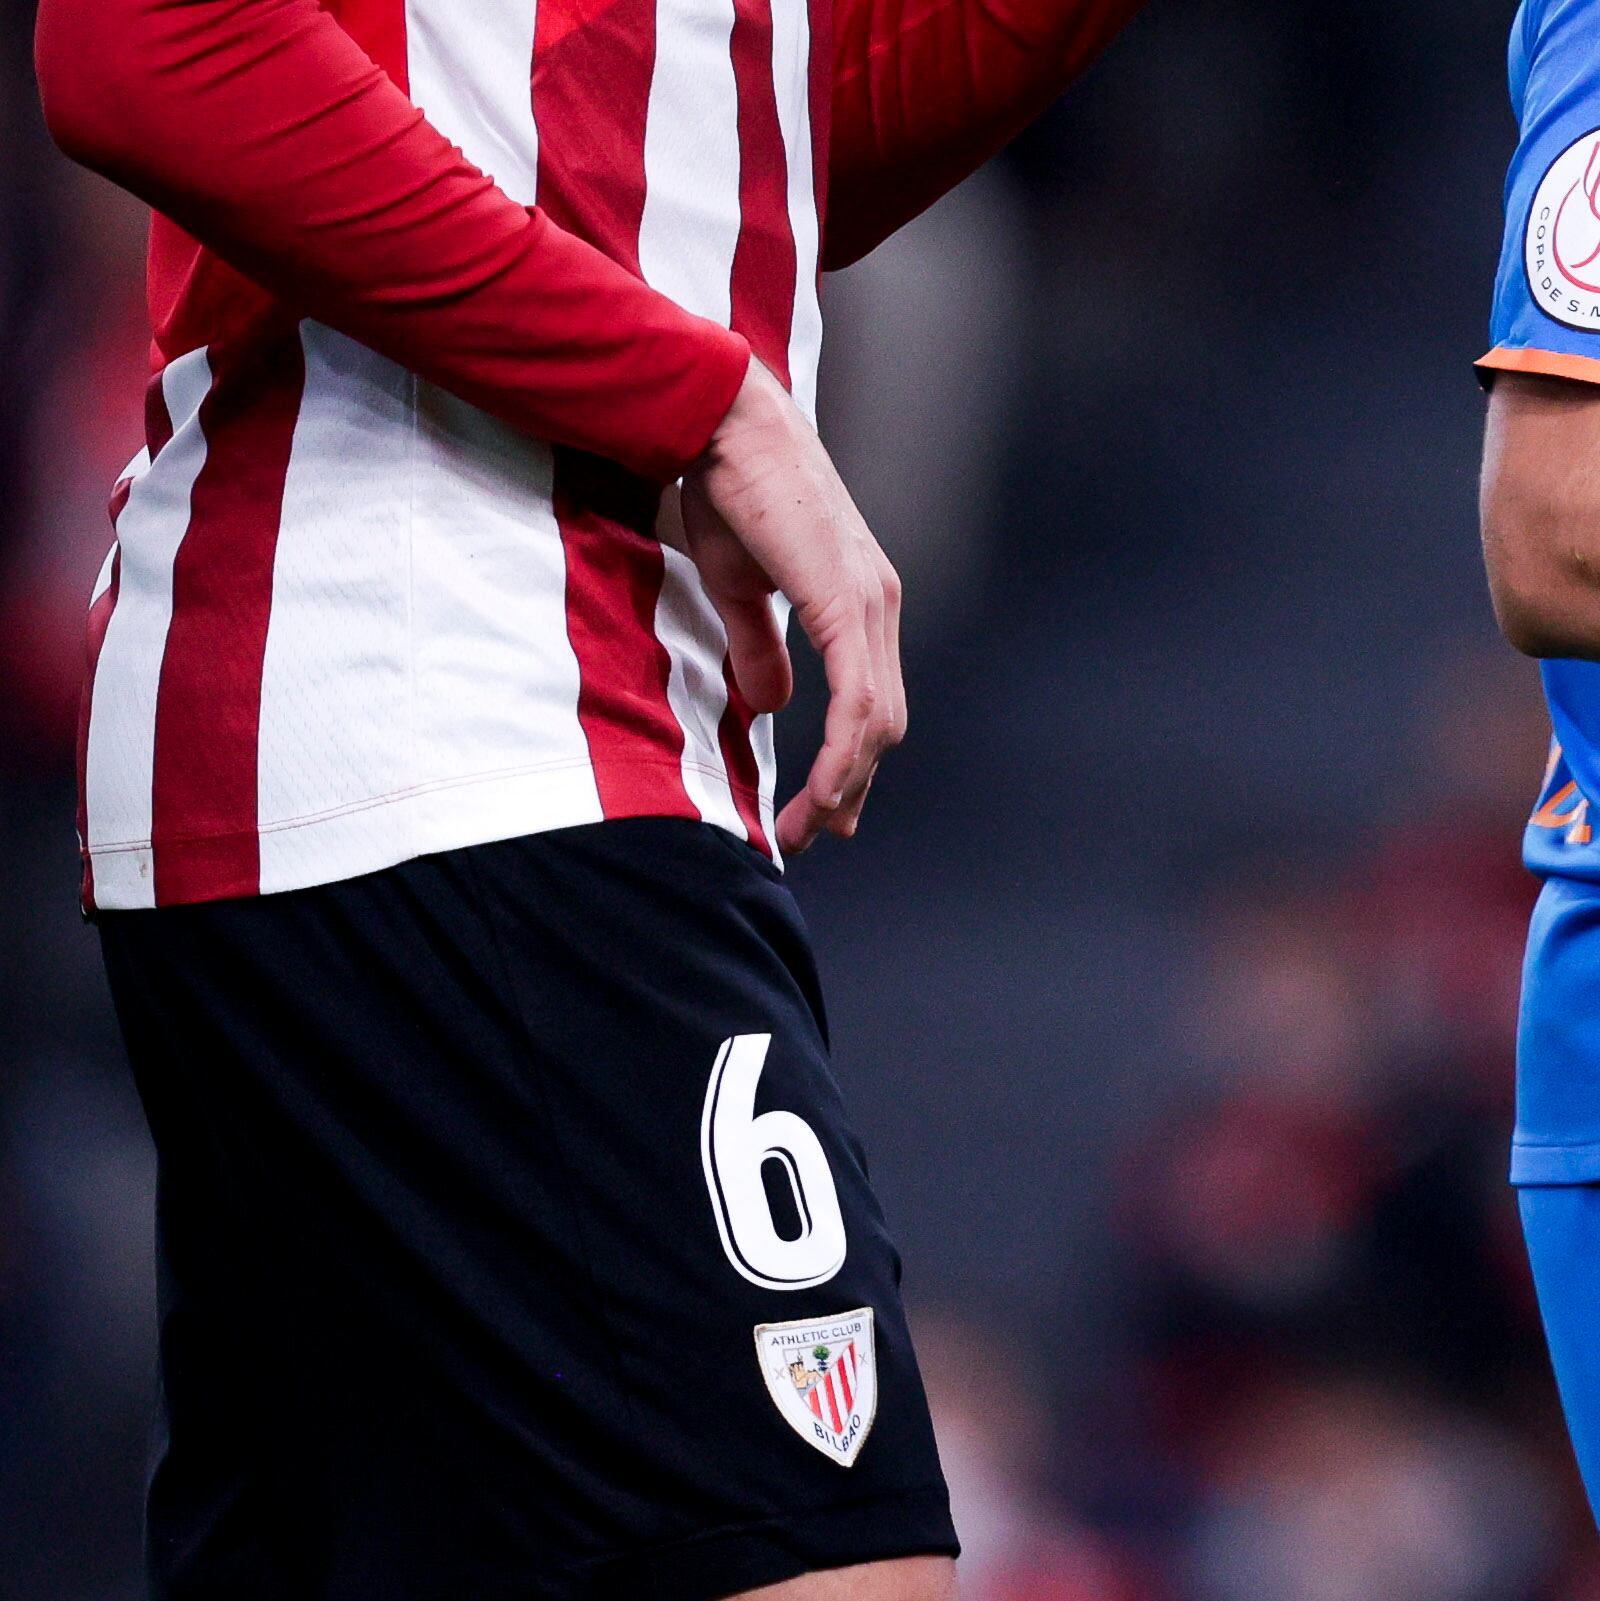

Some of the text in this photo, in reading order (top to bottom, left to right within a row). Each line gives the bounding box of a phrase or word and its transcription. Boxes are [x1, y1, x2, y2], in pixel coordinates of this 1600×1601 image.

[1536, 206, 1551, 273] COPA
[1541, 276, 1562, 302] DE
[700, 1032, 847, 1291] 6
[771, 1322, 863, 1347] ATHLETIC CLUB
[813, 1413, 861, 1452] BILBAO
